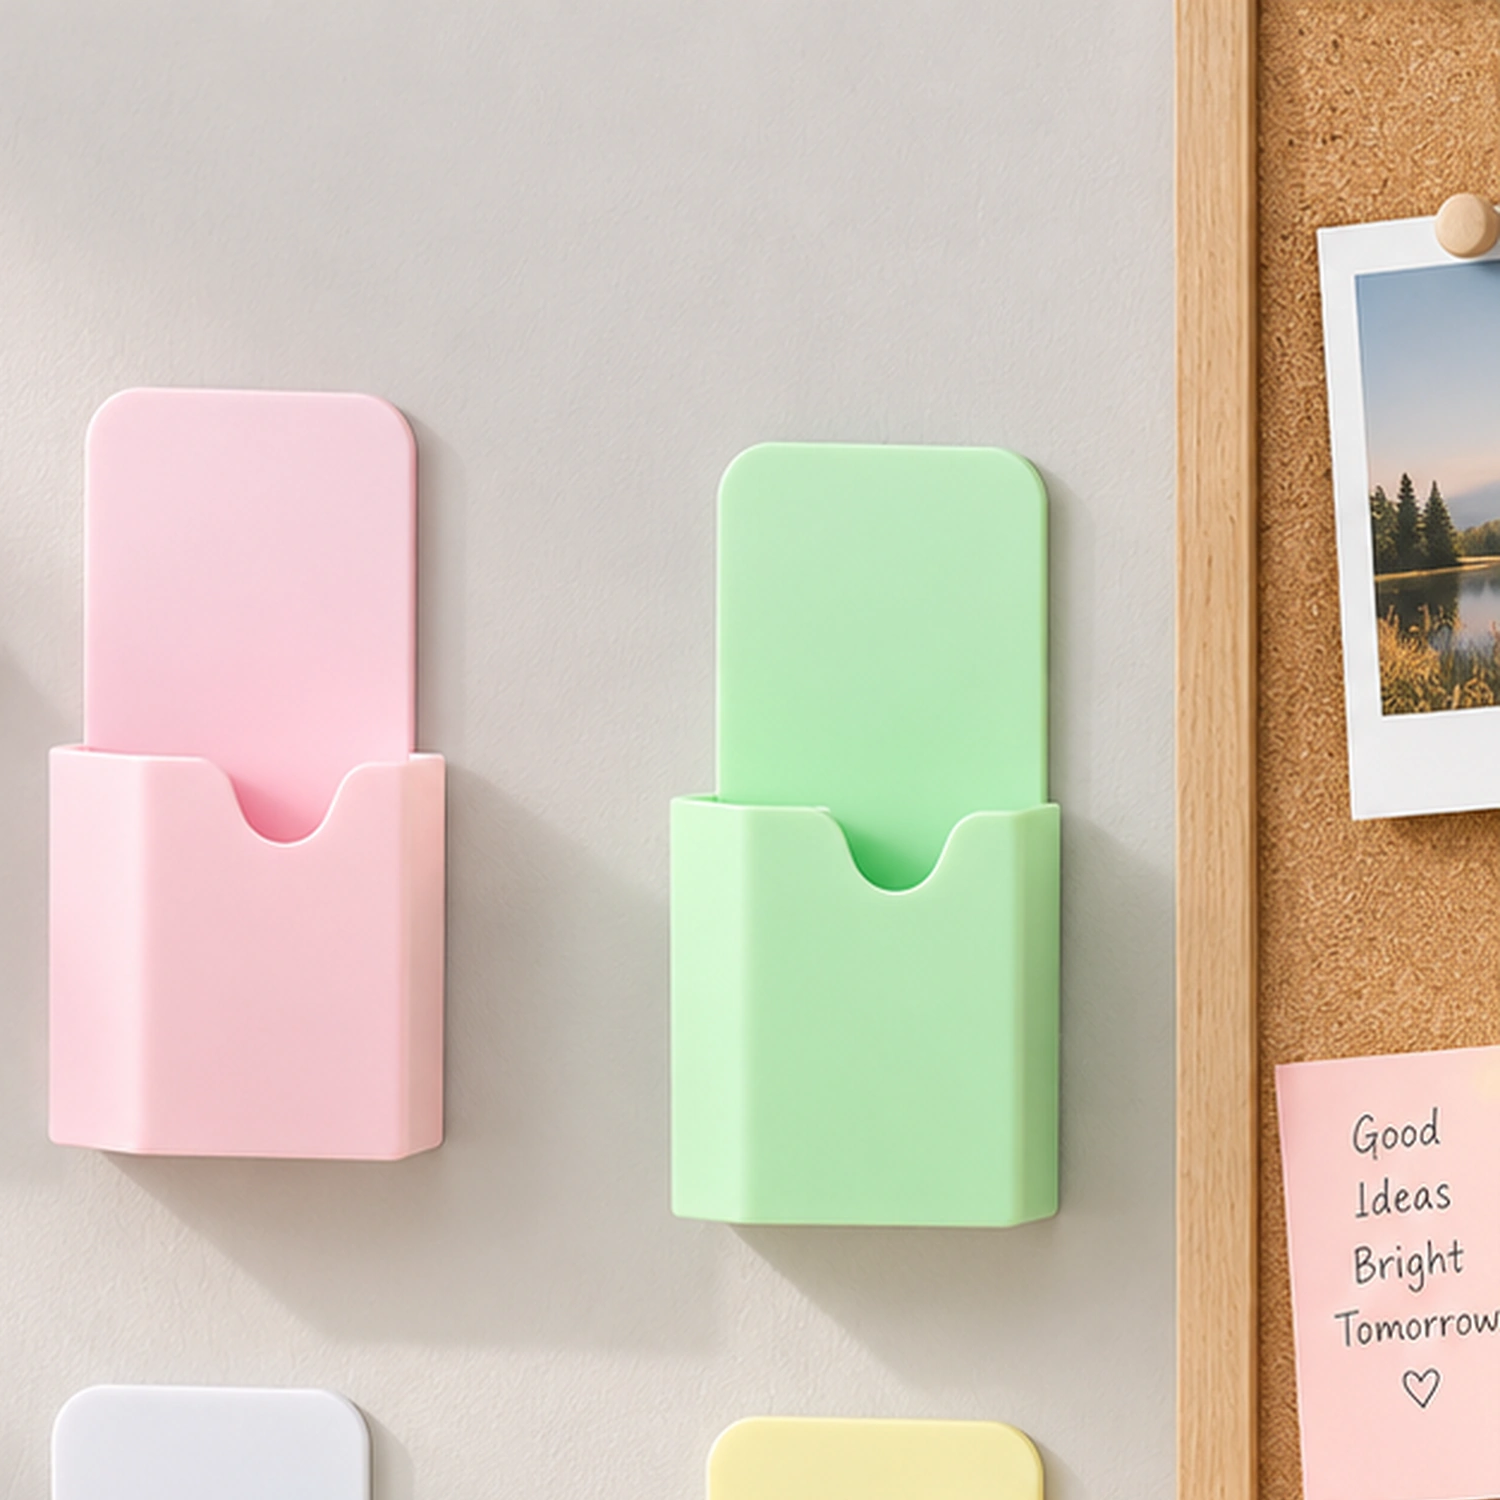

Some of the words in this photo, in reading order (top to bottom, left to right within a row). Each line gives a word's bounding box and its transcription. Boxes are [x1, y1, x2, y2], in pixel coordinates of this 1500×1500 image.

[1352, 1107, 1440, 1160] Good
[1355, 1177, 1451, 1218] Ideas
[1353, 1239, 1464, 1293] Bright
[1334, 1309, 1500, 1347] Tomorrow
